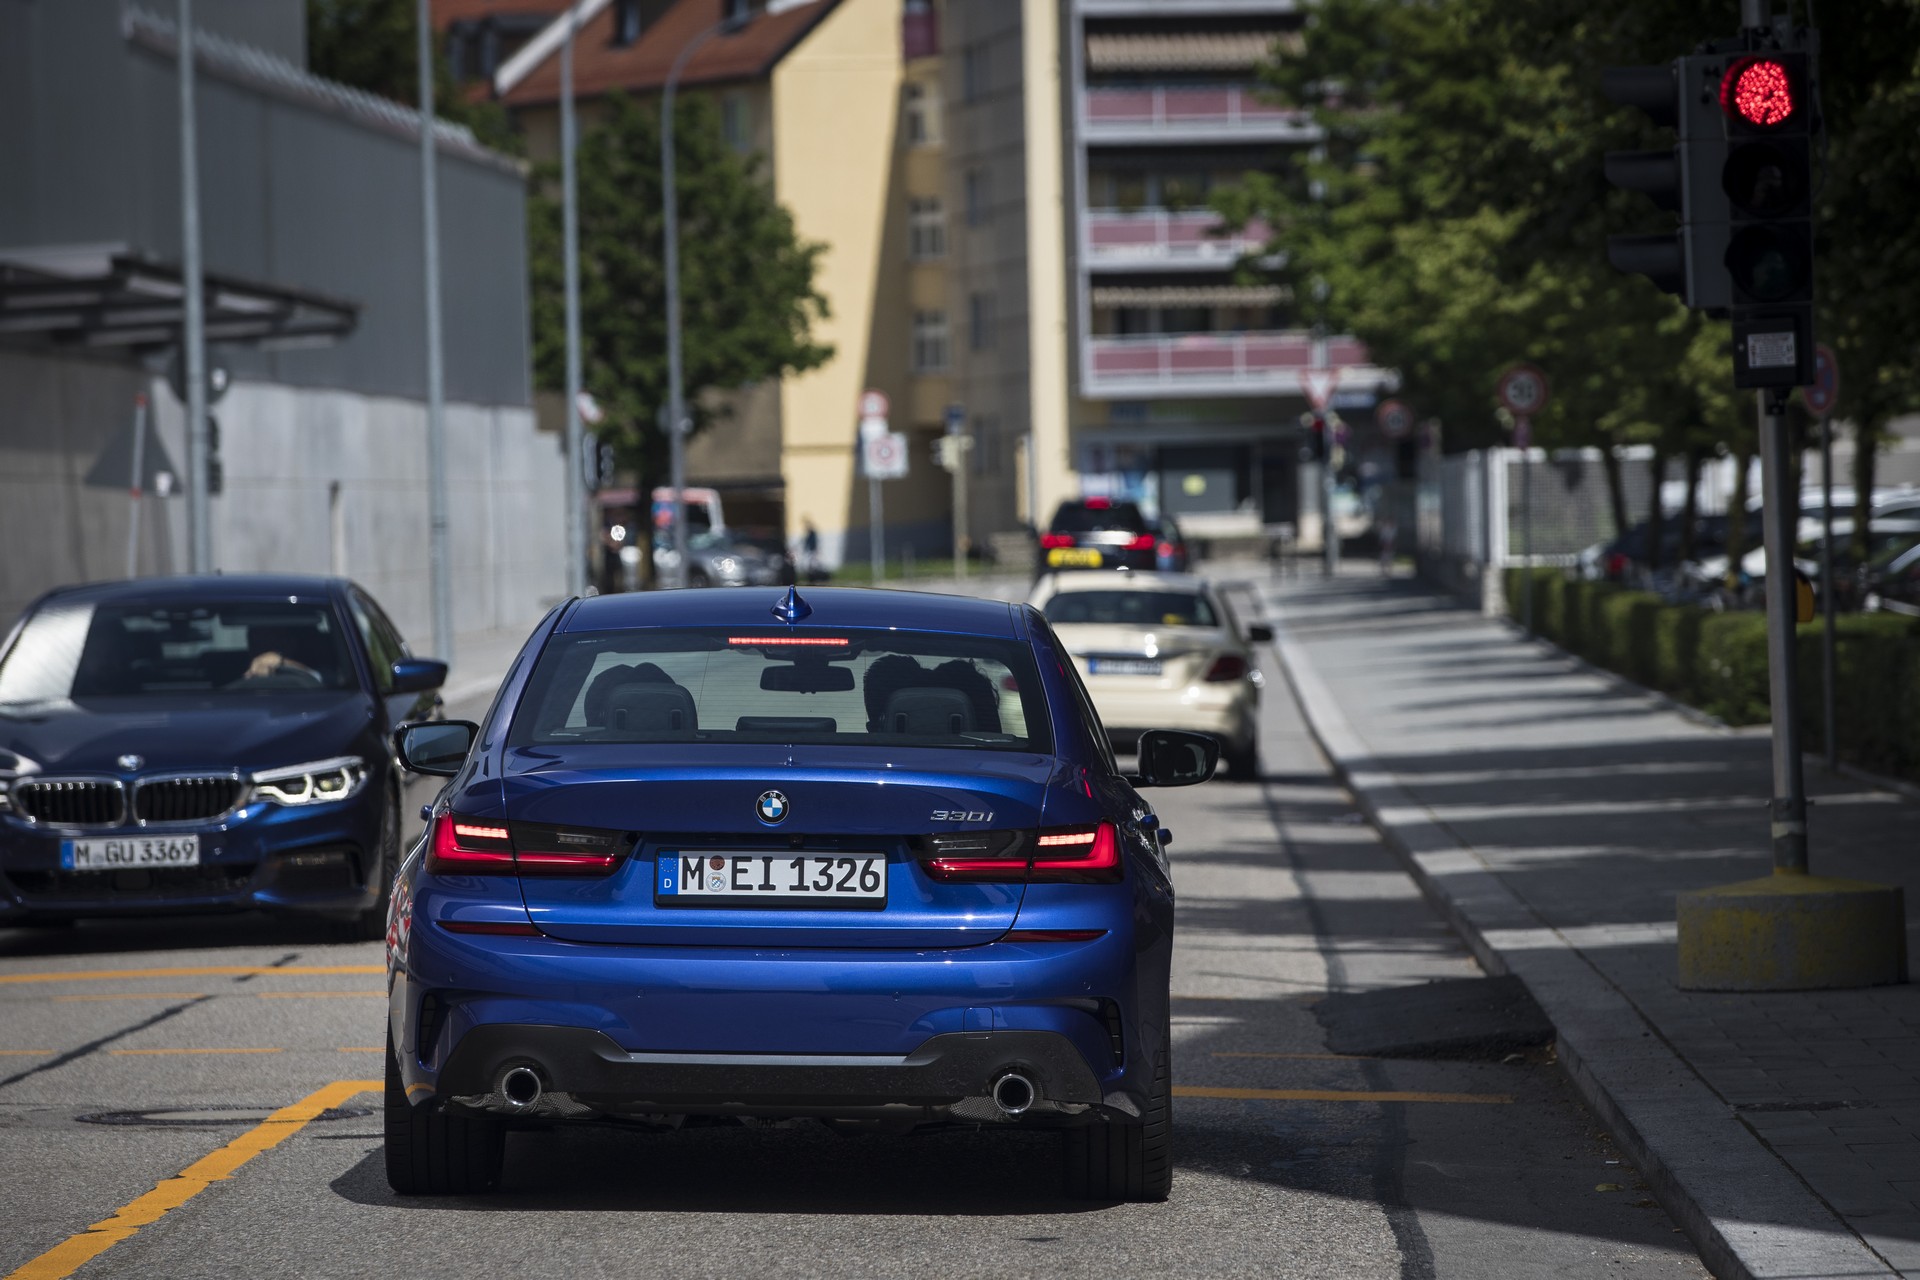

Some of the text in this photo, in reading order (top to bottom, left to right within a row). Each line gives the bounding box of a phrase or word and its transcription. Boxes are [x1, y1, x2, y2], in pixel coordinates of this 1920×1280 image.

[76, 845, 90, 864] M
[105, 842, 134, 863] GU
[140, 840, 195, 861] 3369
[663, 878, 672, 889] D
[681, 856, 704, 890] M
[731, 856, 776, 891] EI
[789, 857, 880, 892] 1326
